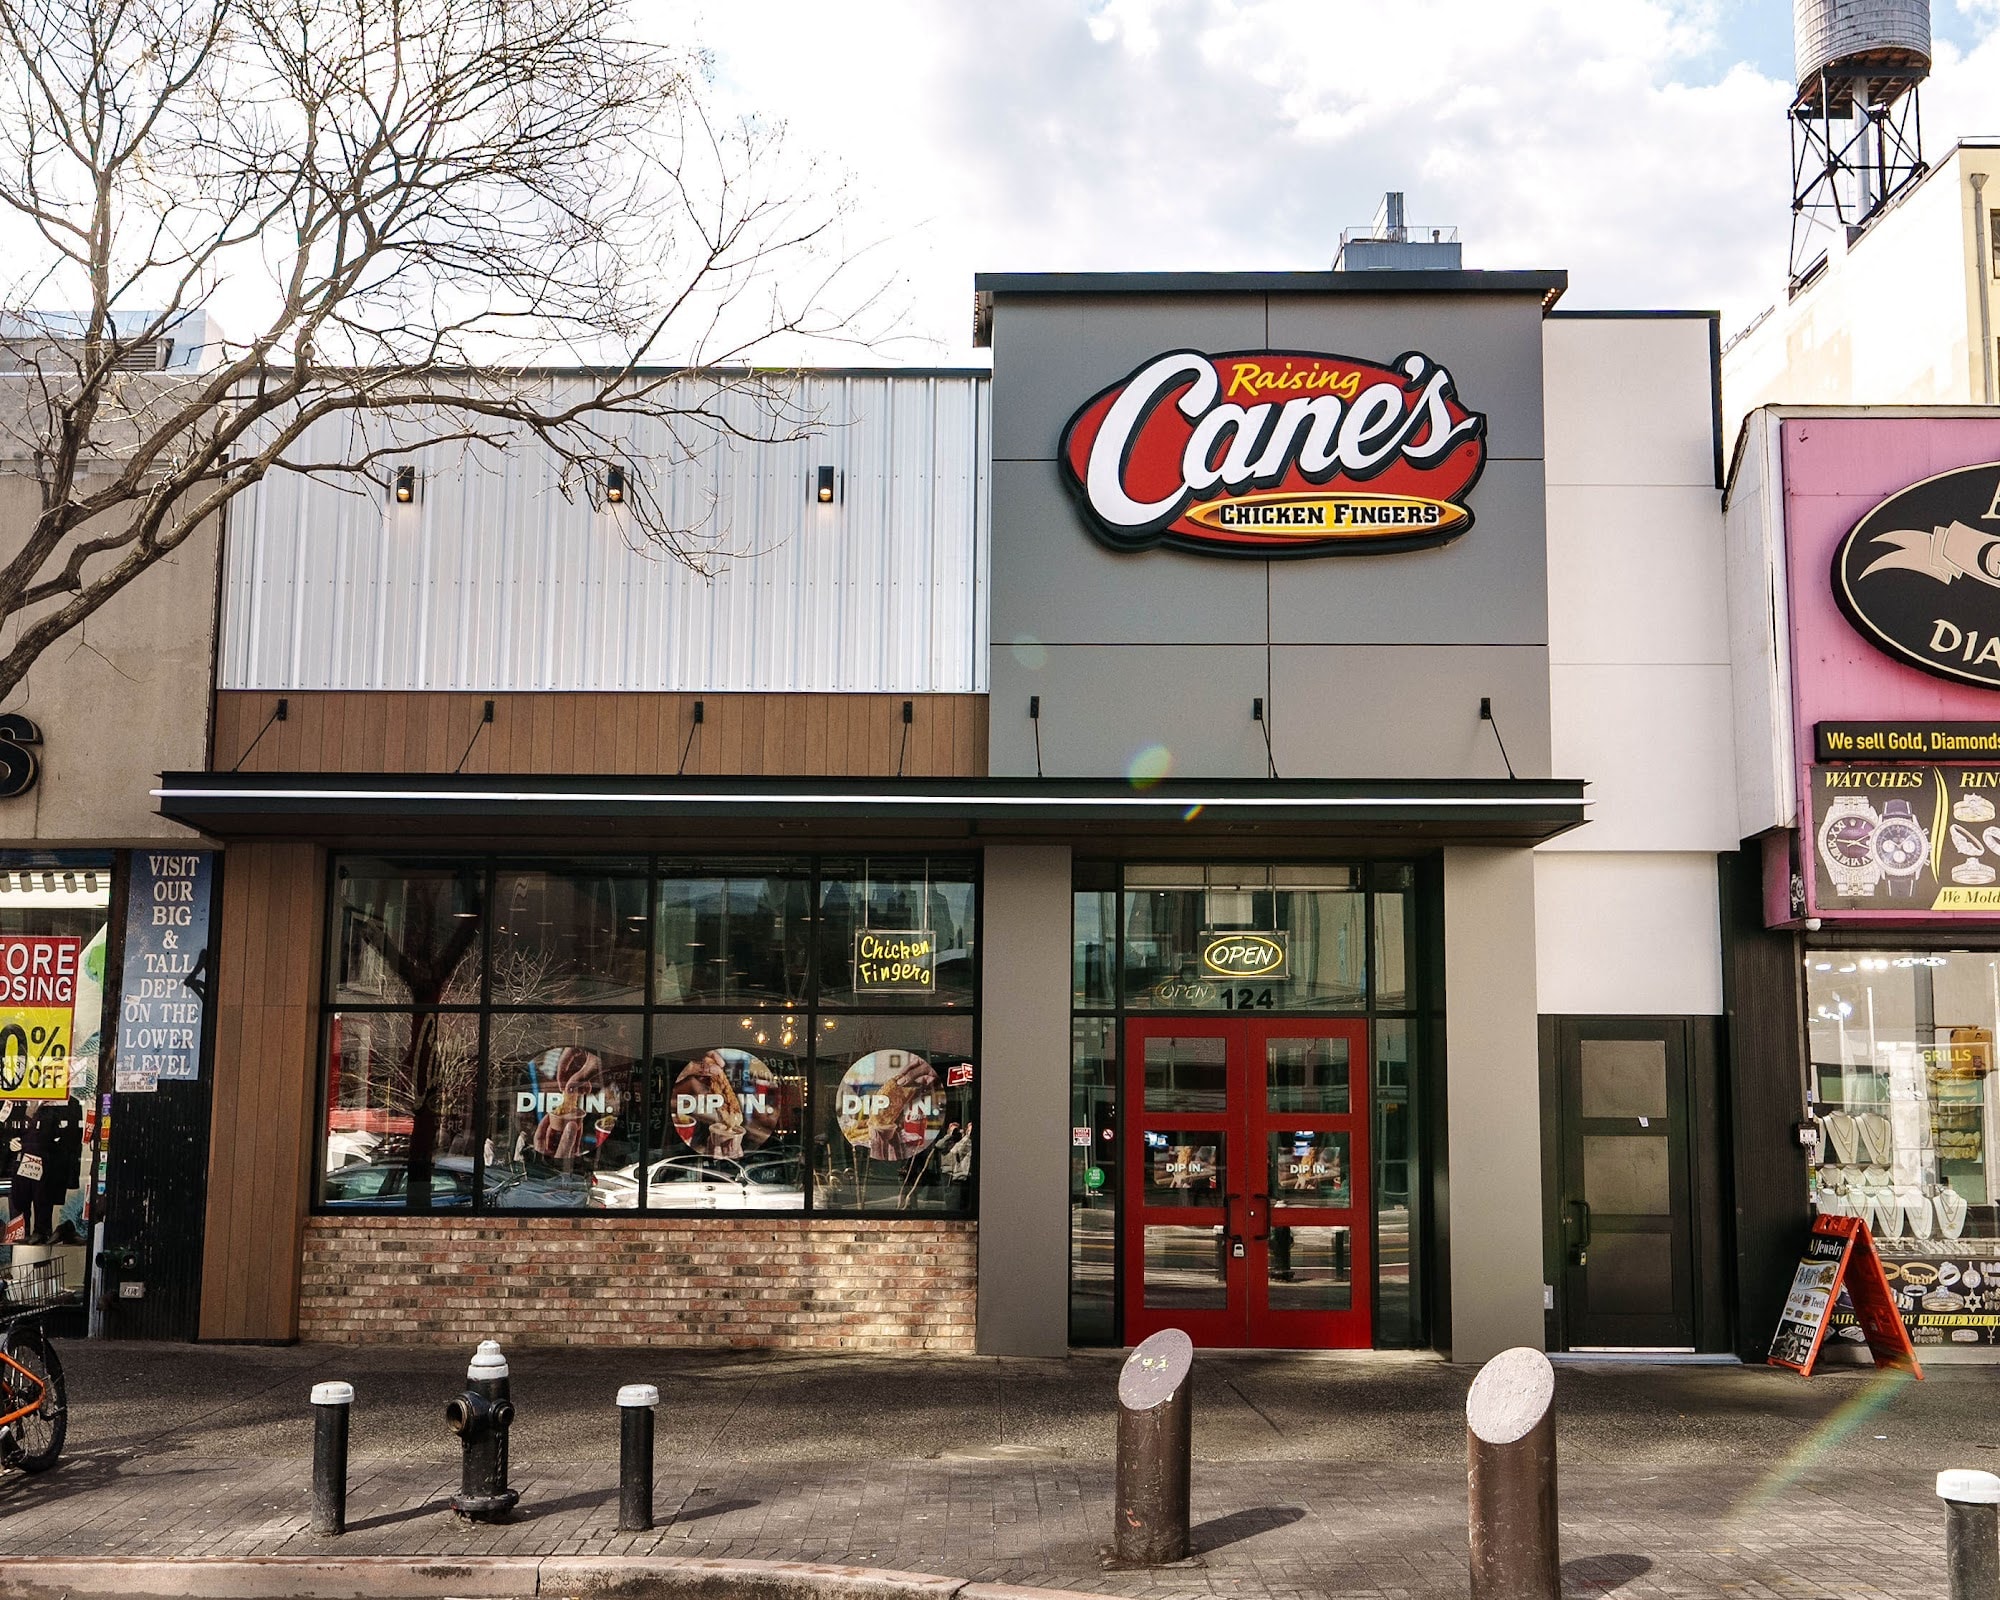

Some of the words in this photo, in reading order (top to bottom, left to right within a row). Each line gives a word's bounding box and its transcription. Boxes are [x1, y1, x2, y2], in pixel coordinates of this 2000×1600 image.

[1228, 363, 1362, 399] Raising
[1087, 352, 1478, 527] Cane's
[1219, 503, 1325, 525] CHICKEN
[1333, 503, 1439, 525] FINGERS
[1827, 732, 1853, 750] We
[1856, 732, 1886, 750] sell
[1888, 732, 1928, 752] Gold,
[1824, 771, 1924, 788] WATCHES
[1959, 771, 2000, 788] RIN
[149, 855, 200, 877] VISIT
[153, 881, 194, 902] OUR
[1942, 890, 1961, 904] We
[151, 905, 193, 926] BIG
[162, 929, 178, 950] &
[861, 935, 930, 960] Chicken
[0, 943, 76, 975] ORE
[144, 953, 195, 973] TALL
[1212, 945, 1274, 966] OPEN
[859, 962, 931, 985] Fingers
[140, 978, 192, 999] DEPT.
[1220, 988, 1274, 1010] 124
[125, 1003, 151, 1023] ON
[159, 1003, 199, 1024] THE
[125, 1029, 195, 1050] LOWER
[130, 1054, 191, 1077] LEVEL
[1922, 1049, 1972, 1062] GRILLS
[28, 1065, 64, 1089] OFF
[517, 1091, 565, 1113] DIP
[580, 1091, 614, 1114] IN.
[677, 1093, 725, 1115] DIP
[738, 1093, 774, 1114] IN.
[842, 1094, 890, 1116] DIP
[1165, 1163, 1187, 1173] DIP
[1188, 1163, 1204, 1173] IN.
[1289, 1164, 1310, 1174] DIP
[1312, 1164, 1328, 1174] IN.
[1921, 1315, 1964, 1325] WHILE
[1965, 1315, 1992, 1325] YOU
